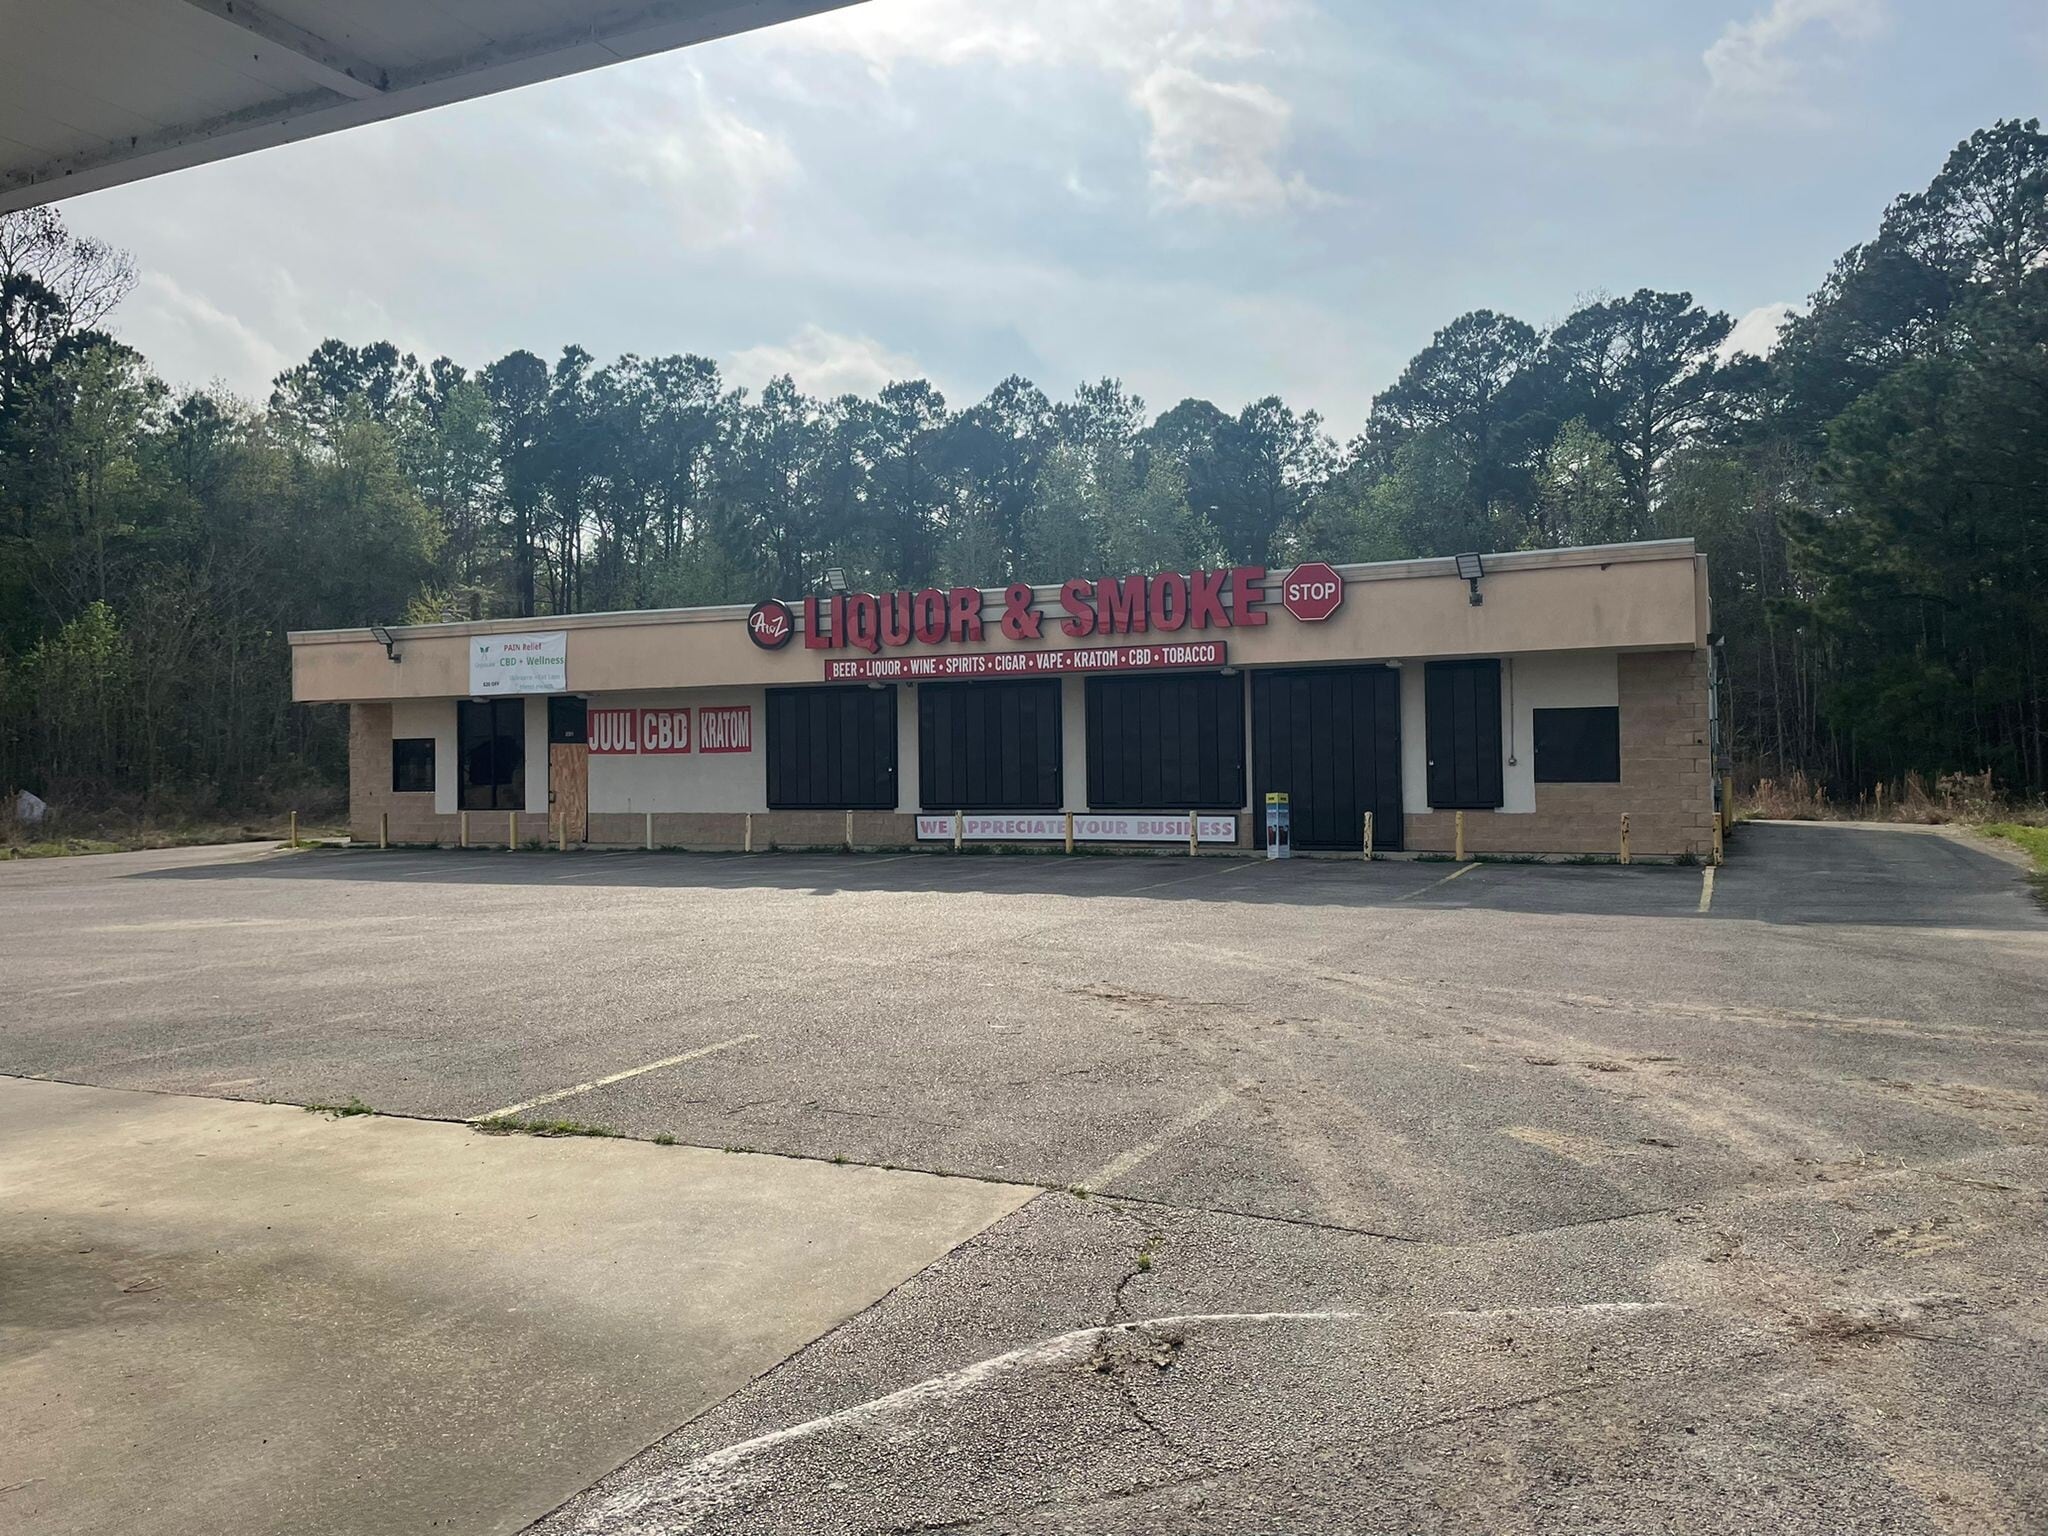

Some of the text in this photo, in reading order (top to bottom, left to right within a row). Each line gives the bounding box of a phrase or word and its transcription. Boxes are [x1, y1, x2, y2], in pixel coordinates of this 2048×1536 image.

[1289, 582, 1336, 601] STOP
[804, 567, 1268, 654] LIQUOR & SMOKE
[500, 658, 517, 667] CBD
[526, 656, 564, 665] Wellness
[503, 643, 542, 652] PAIN Relief
[833, 646, 1215, 677] BEER LIQUOR WINE SPIRITS CIGAR VAPE KRATOM CBD TOBACCO
[589, 713, 636, 750] JUUL
[643, 712, 688, 750] CBD
[701, 711, 750, 748] KRATOM
[920, 820, 947, 834] WE
[1075, 821, 1128, 835] YOUR
